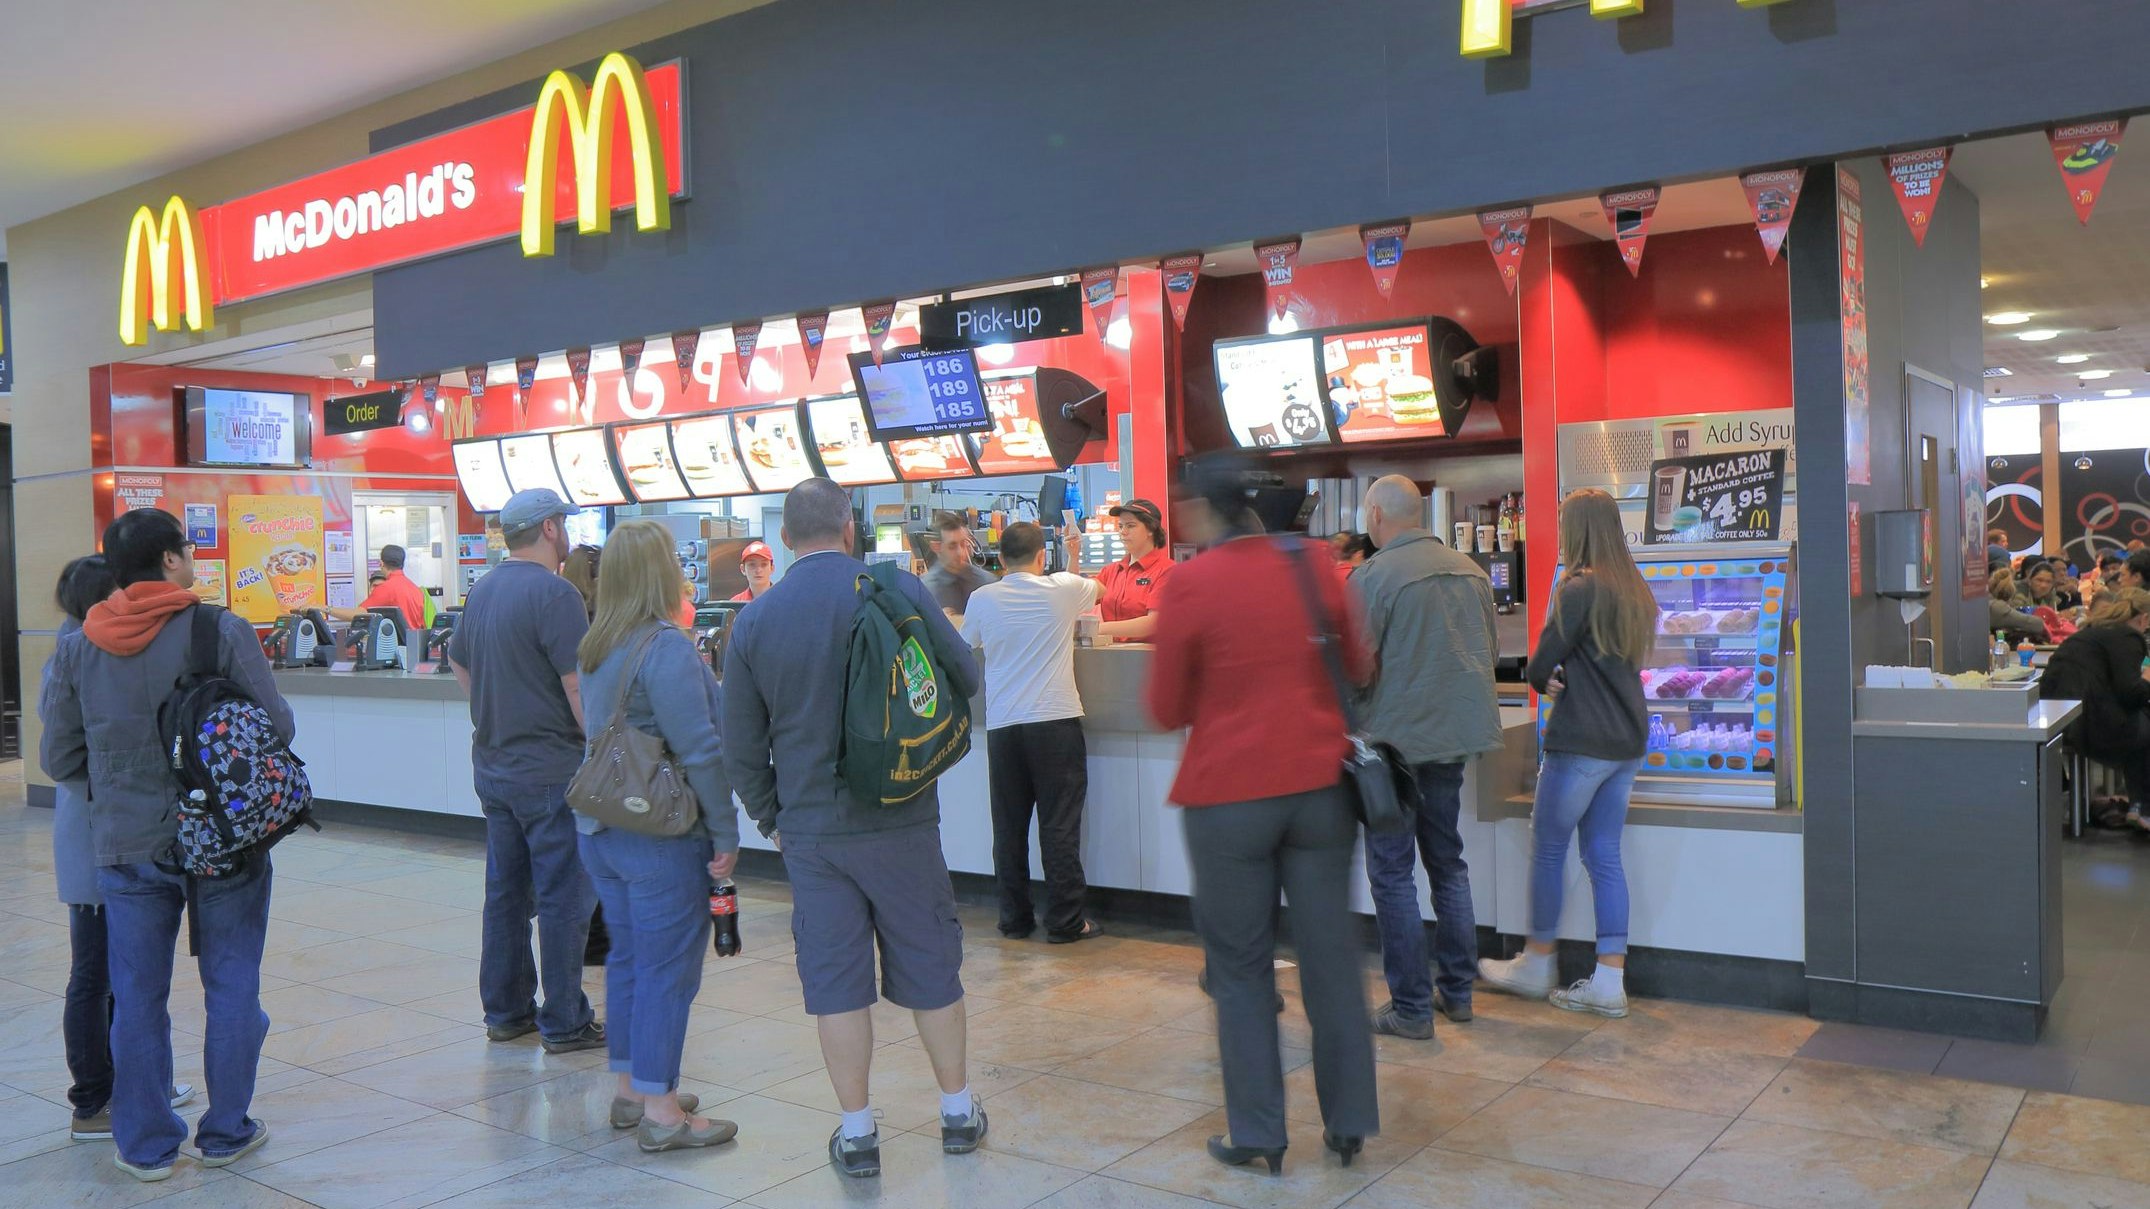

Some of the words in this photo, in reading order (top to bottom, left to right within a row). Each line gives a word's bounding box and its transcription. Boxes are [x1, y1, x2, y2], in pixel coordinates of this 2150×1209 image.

[2058, 124, 2116, 137] MONOPOLY
[1892, 150, 1944, 164] MONOPOLY
[1890, 160, 1944, 177] MILLIONS
[1749, 171, 1796, 184] MONOPOLY
[1904, 181, 1918, 190] TO
[1608, 191, 1653, 204] MONOPOLY
[253, 160, 476, 262] McDonald's
[1485, 210, 1524, 221] MONOPOLY
[1260, 243, 1296, 256] MONOPOLY
[1265, 266, 1292, 281] WIN
[956, 306, 1042, 337] Pick-up
[900, 351, 919, 360] Your
[923, 357, 964, 378] 186
[929, 379, 969, 399] 189
[346, 403, 380, 424] Order
[935, 400, 975, 420] 185
[232, 416, 281, 440] welcome
[1706, 421, 1743, 444] Add
[1689, 451, 1772, 487] MACARON
[120, 477, 160, 485] MONOPOLY
[1697, 480, 1741, 495] STANDARD
[1742, 471, 1775, 485] COFFEE
[117, 488, 136, 497] ALL
[137, 488, 163, 497] THESE
[1715, 531, 1737, 540] COFFEE
[1738, 529, 1755, 539] ONLY
[239, 567, 255, 578] IT'S
[236, 573, 264, 589] BACK!
[912, 685, 936, 710] MILO
